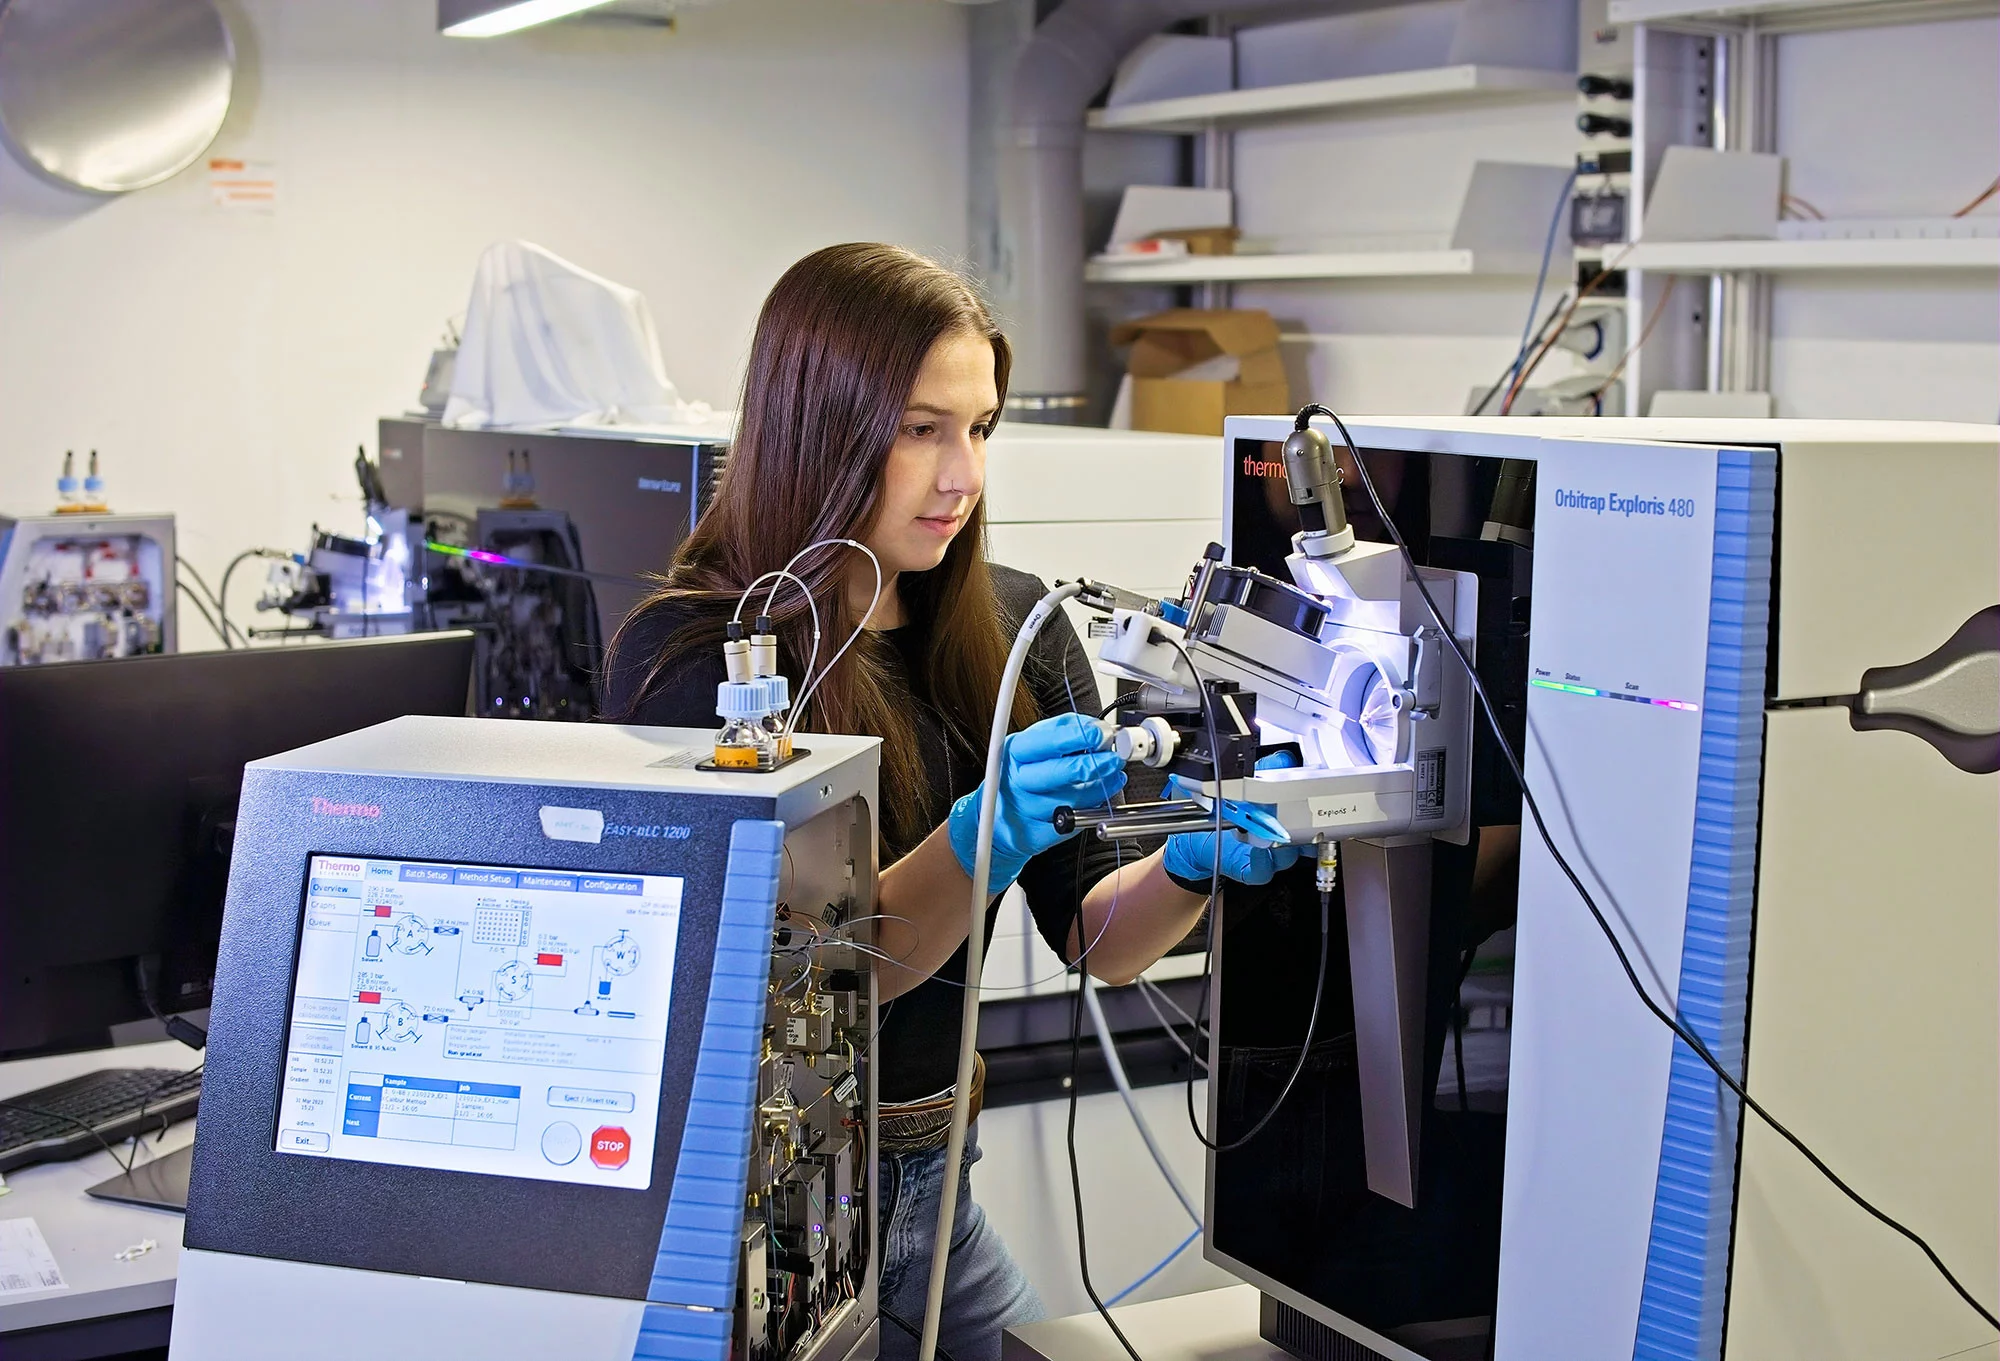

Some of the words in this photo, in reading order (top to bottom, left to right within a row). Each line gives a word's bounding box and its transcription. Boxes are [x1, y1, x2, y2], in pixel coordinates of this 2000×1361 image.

[1555, 488, 1605, 515] Orbitrap
[1608, 493, 1665, 517] Exploris
[1668, 498, 1694, 518] 480
[1535, 668, 1551, 677] Power
[1625, 682, 1639, 691] Scan
[312, 796, 381, 818] Thermo
[603, 823, 661, 838] EASY-nLC
[663, 825, 691, 840] 1200
[318, 860, 361, 872] Thermo
[371, 867, 393, 877] Home
[405, 869, 425, 879] Batch
[427, 871, 448, 881] Setup
[460, 872, 488, 883] Method
[490, 874, 512, 885] Setup
[523, 876, 572, 888] Maintenance
[312, 883, 349, 893] Overview
[584, 879, 637, 891] Configuration
[308, 917, 331, 927] Queue
[406, 929, 414, 938] A
[616, 951, 626, 960] W
[511, 975, 517, 984] S
[397, 1017, 404, 1026] B
[384, 1077, 407, 1086] Sample
[348, 1093, 372, 1102] Current
[596, 1140, 625, 1152] STOP
